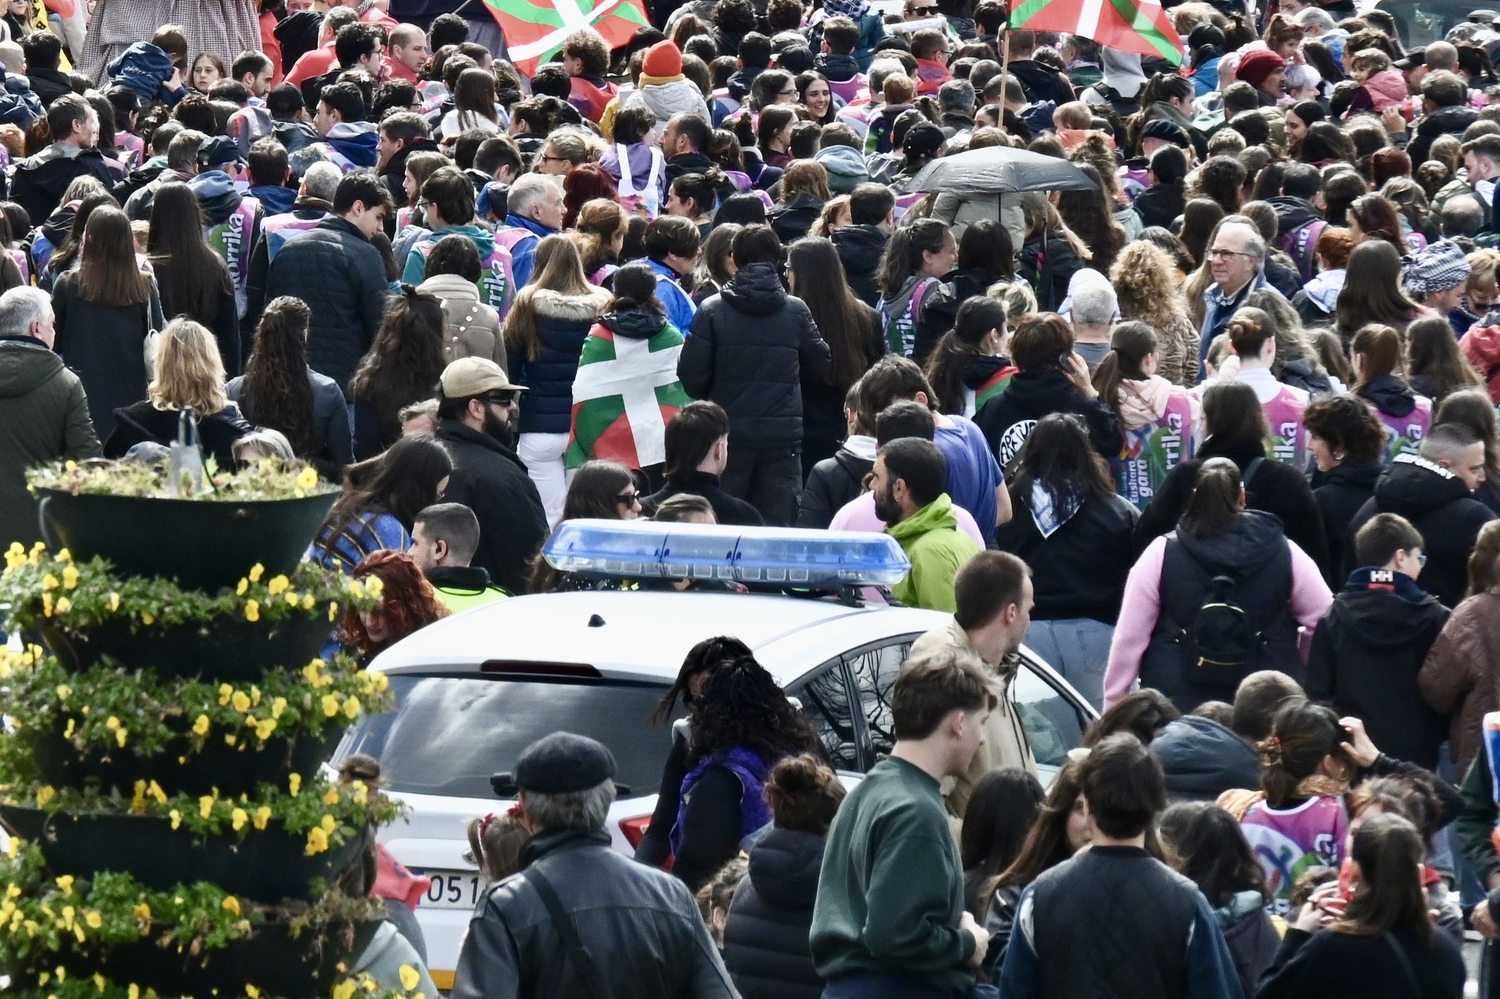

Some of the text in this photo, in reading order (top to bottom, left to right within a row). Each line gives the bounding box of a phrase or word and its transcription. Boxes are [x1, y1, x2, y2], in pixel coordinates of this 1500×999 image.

[484, 259, 506, 312] rrika
[1160, 412, 1183, 471] rrika
[1128, 460, 1139, 504] Euskara
[1137, 459, 1153, 497] gara
[1370, 570, 1394, 583] HH
[427, 874, 480, 906] 051
